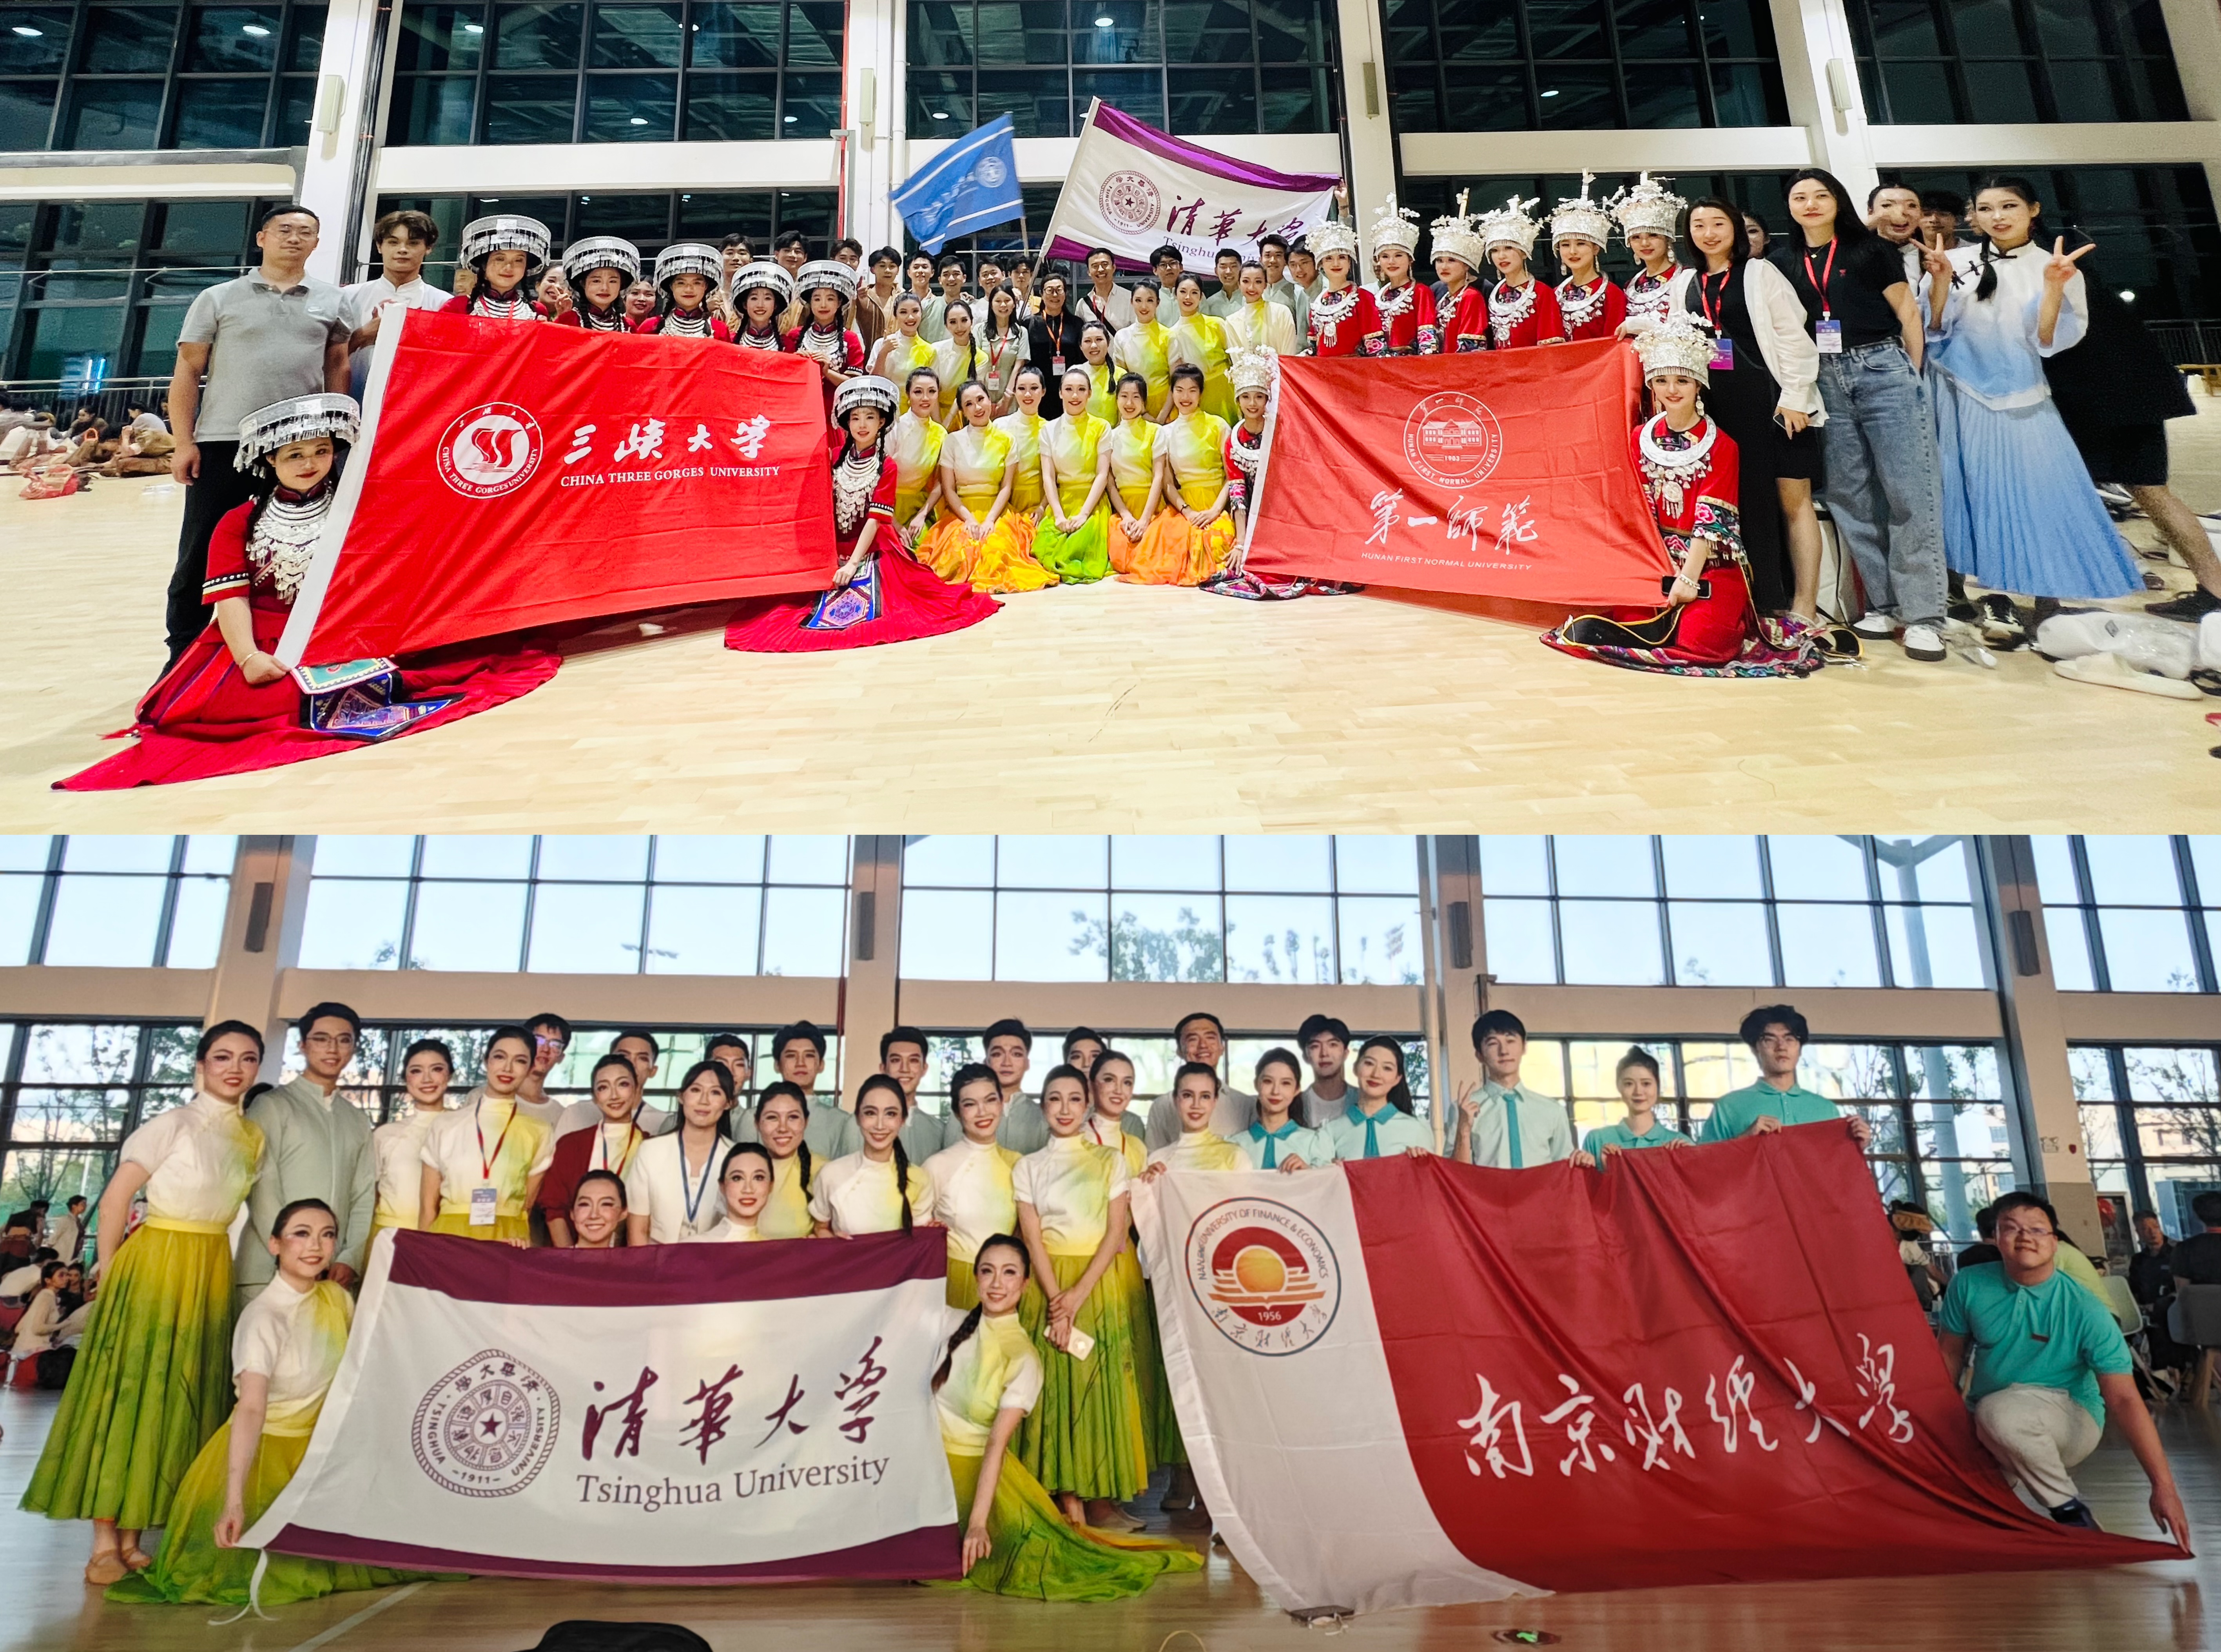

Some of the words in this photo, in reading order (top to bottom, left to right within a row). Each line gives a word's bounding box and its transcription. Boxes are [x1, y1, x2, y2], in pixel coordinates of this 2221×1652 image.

[1136, 203, 1155, 227] UNIVERSITY
[1163, 236, 1215, 258] Tsinghu
[442, 446, 452, 473] CHINA
[449, 472, 473, 492] THREE
[475, 484, 508, 494] GORGES
[508, 447, 538, 487] UNIVERSITY
[560, 473, 605, 487] CHINA
[607, 471, 651, 484] THREE
[654, 466, 704, 481] GORGES
[710, 466, 781, 477] UNIVERSITY
[1407, 433, 1417, 457] HUNAN
[1414, 460, 1436, 479] FIRST
[1439, 476, 1470, 485] NORMAL
[1474, 433, 1498, 479] UNIVERSITY
[1360, 552, 1394, 562] HUNAN
[1394, 555, 1423, 564] FIRST
[1424, 559, 1465, 567] NORMAL
[1467, 561, 1532, 570] UNIVERSITY
[1198, 1210, 1238, 1244] UNIVERSITY
[1239, 1209, 1251, 1218] OF
[1253, 1209, 1291, 1228] FINANCE
[1290, 1223, 1297, 1232] &
[1296, 1228, 1329, 1279] ECONOMICS
[1257, 1311, 1282, 1322] 1956
[427, 1402, 447, 1465] TSINGHUA
[511, 1407, 545, 1477] UNIVERSITY
[576, 1474, 722, 1513] Tsinghua
[734, 1456, 890, 1499] University
